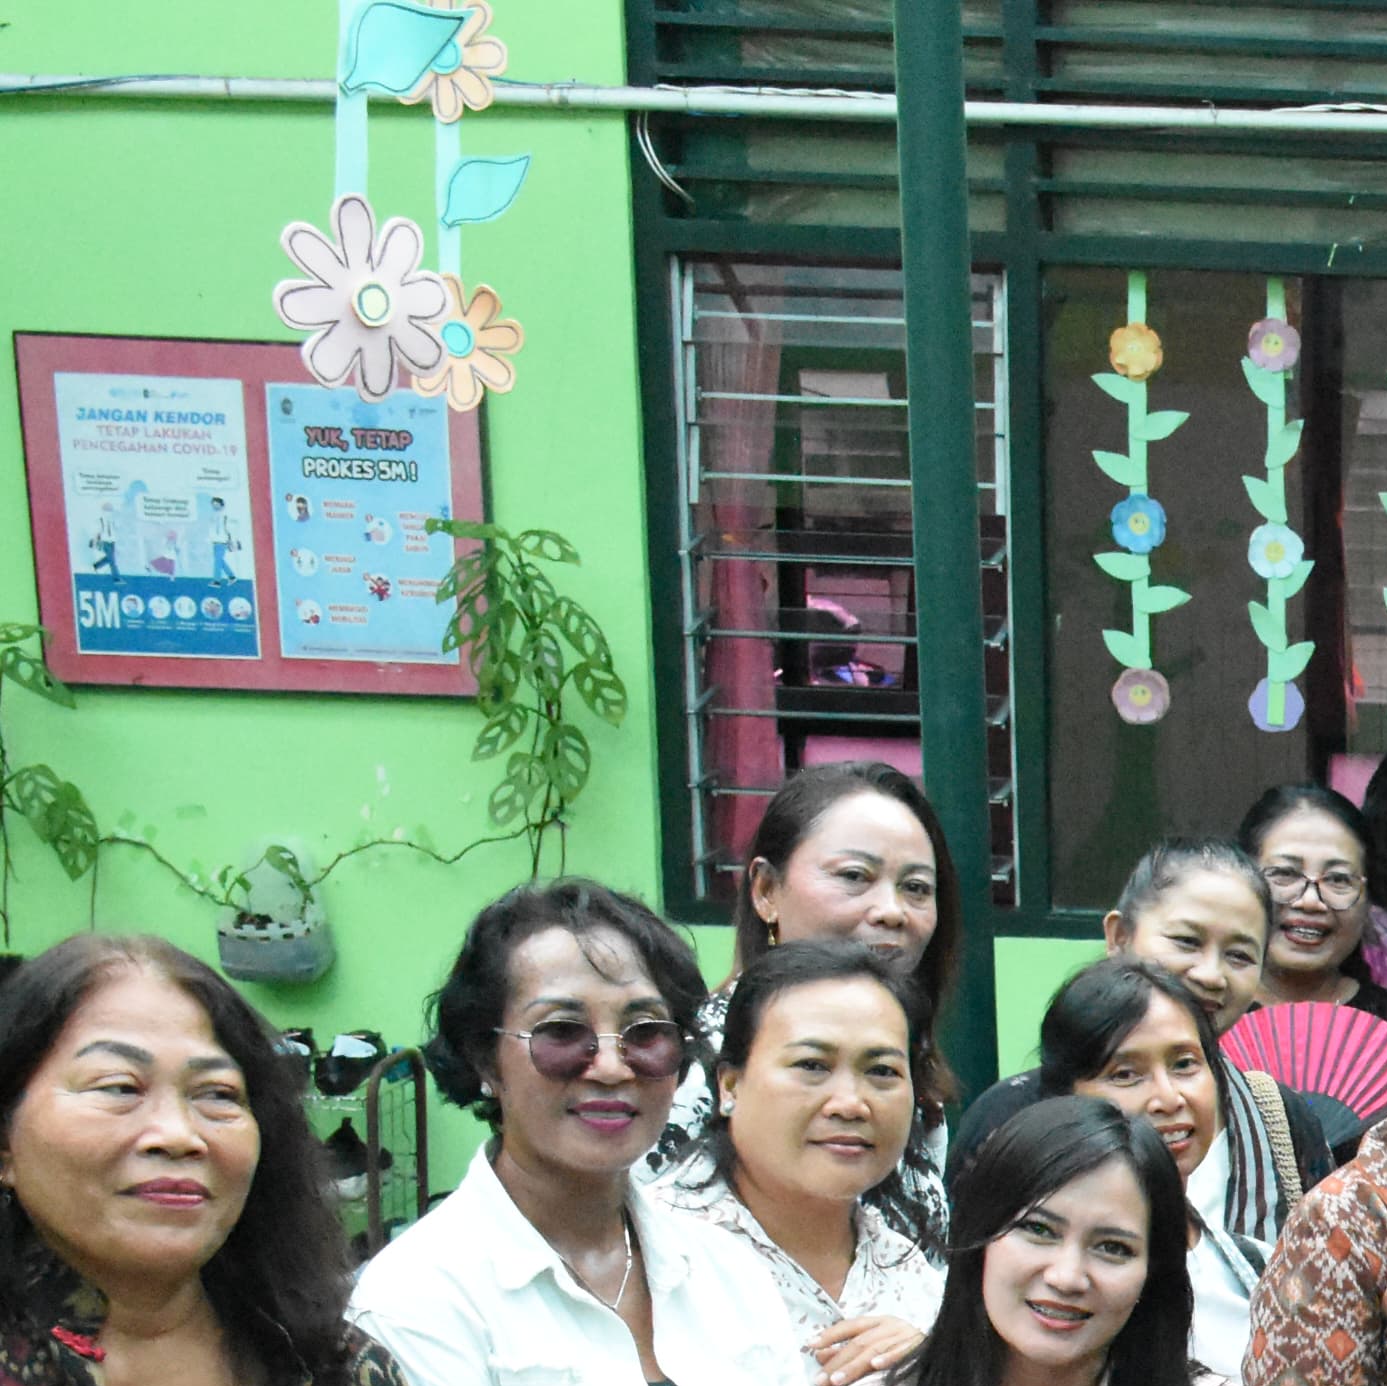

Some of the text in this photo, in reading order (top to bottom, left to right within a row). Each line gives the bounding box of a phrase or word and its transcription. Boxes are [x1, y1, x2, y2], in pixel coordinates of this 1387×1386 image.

[76, 407, 226, 425] JANGAN KENDOR
[97, 425, 212, 440] TETAP LAKUKAN
[304, 426, 413, 452] YUK, TETAP
[73, 439, 238, 456] PENCEGAHAN COVID-19
[303, 456, 376, 480] PROKES
[378, 459, 408, 481] 5M
[79, 590, 121, 629] 5M
